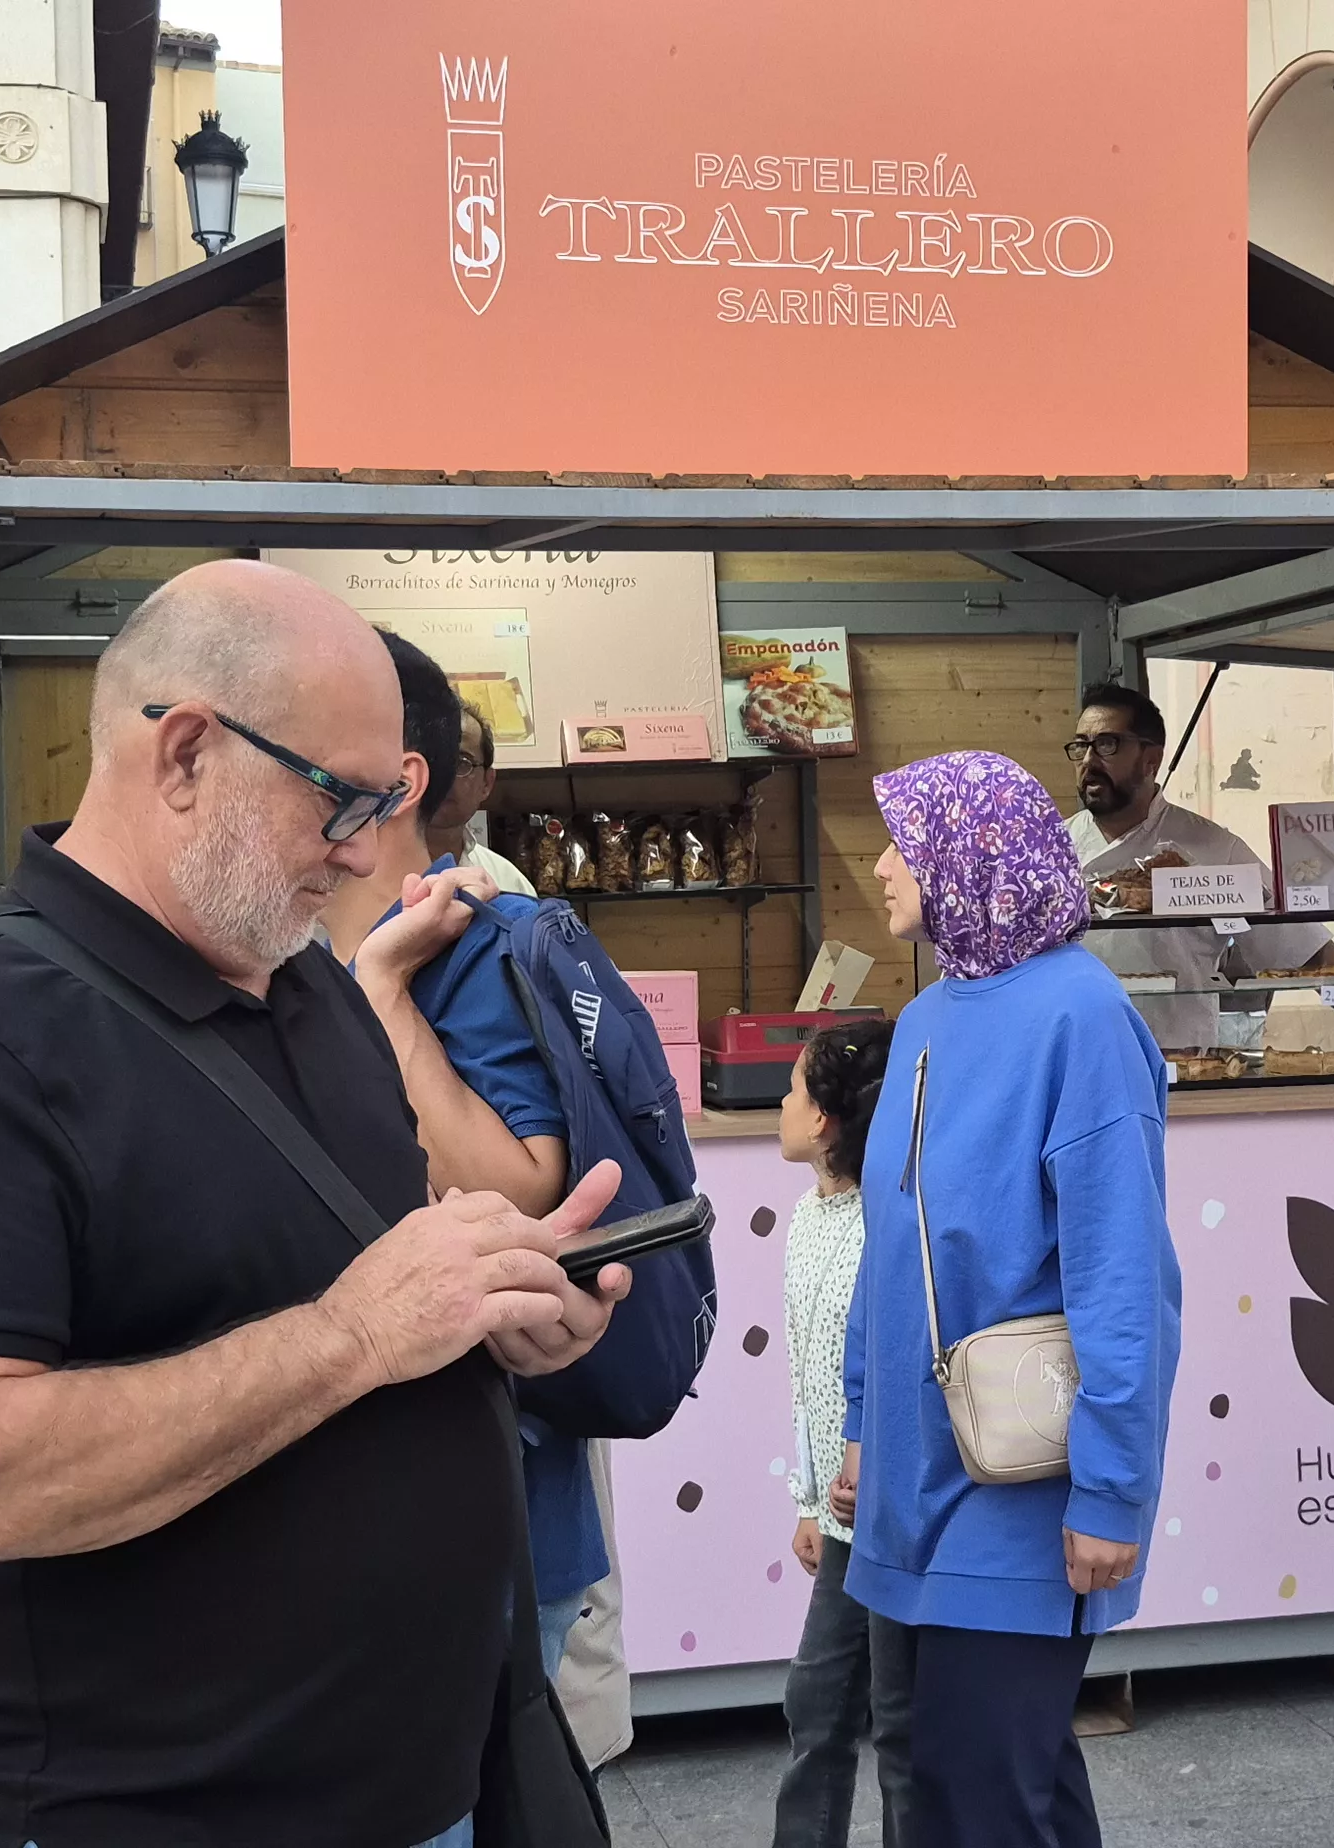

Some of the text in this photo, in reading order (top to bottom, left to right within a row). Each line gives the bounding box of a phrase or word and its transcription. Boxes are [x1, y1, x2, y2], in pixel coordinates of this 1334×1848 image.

[694, 152, 977, 199] PASTELERÍA
[538, 193, 1114, 278] TRALLERO
[716, 282, 957, 329] SARIÑENA
[345, 572, 638, 596] Borrachitos de Sariñena y Monegros
[726, 638, 841, 658] Empanadón
[1169, 874, 1235, 889] TEJAS DE
[1167, 892, 1245, 908] ALMENDRA
